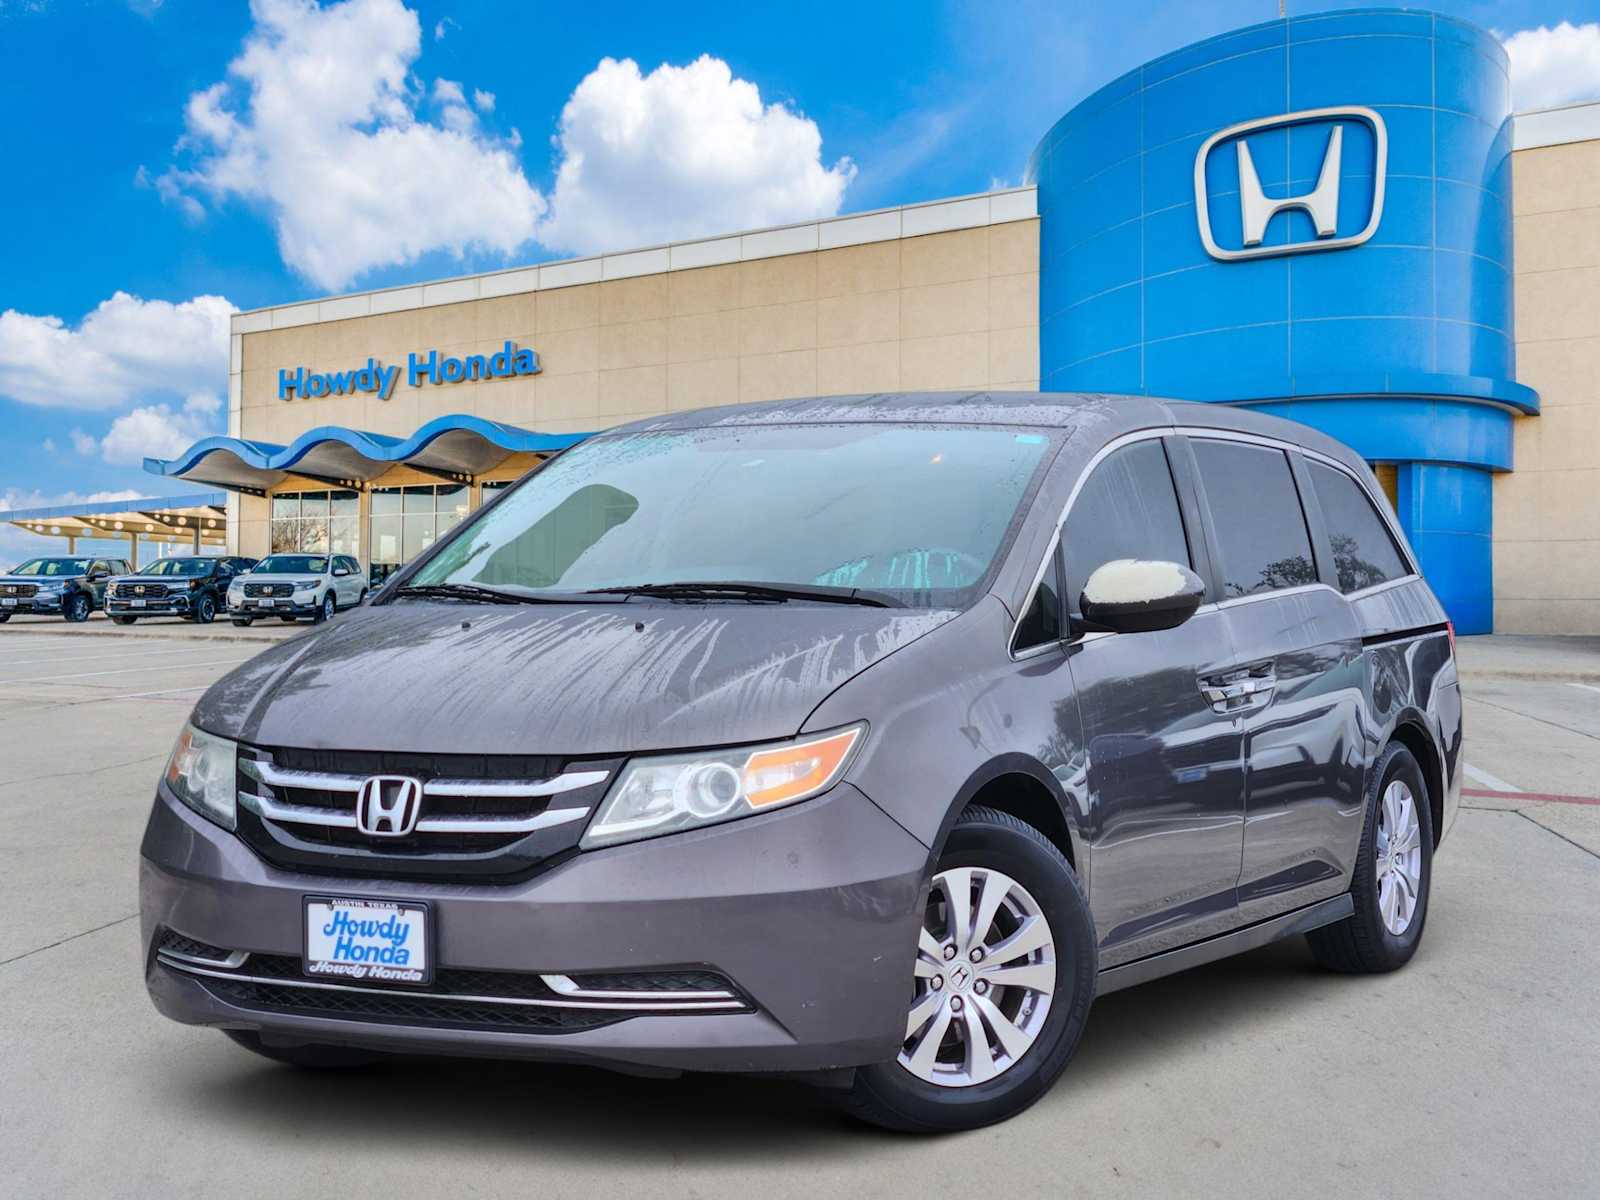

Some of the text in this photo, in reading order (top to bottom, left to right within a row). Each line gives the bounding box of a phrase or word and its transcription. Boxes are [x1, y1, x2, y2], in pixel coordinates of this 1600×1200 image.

[278, 340, 541, 401] Howdy Honda
[331, 899, 399, 910] AUSTIN TEXAS
[323, 911, 410, 946] Howdy
[333, 936, 410, 965] Honda
[309, 961, 423, 981] Howdy Honda
